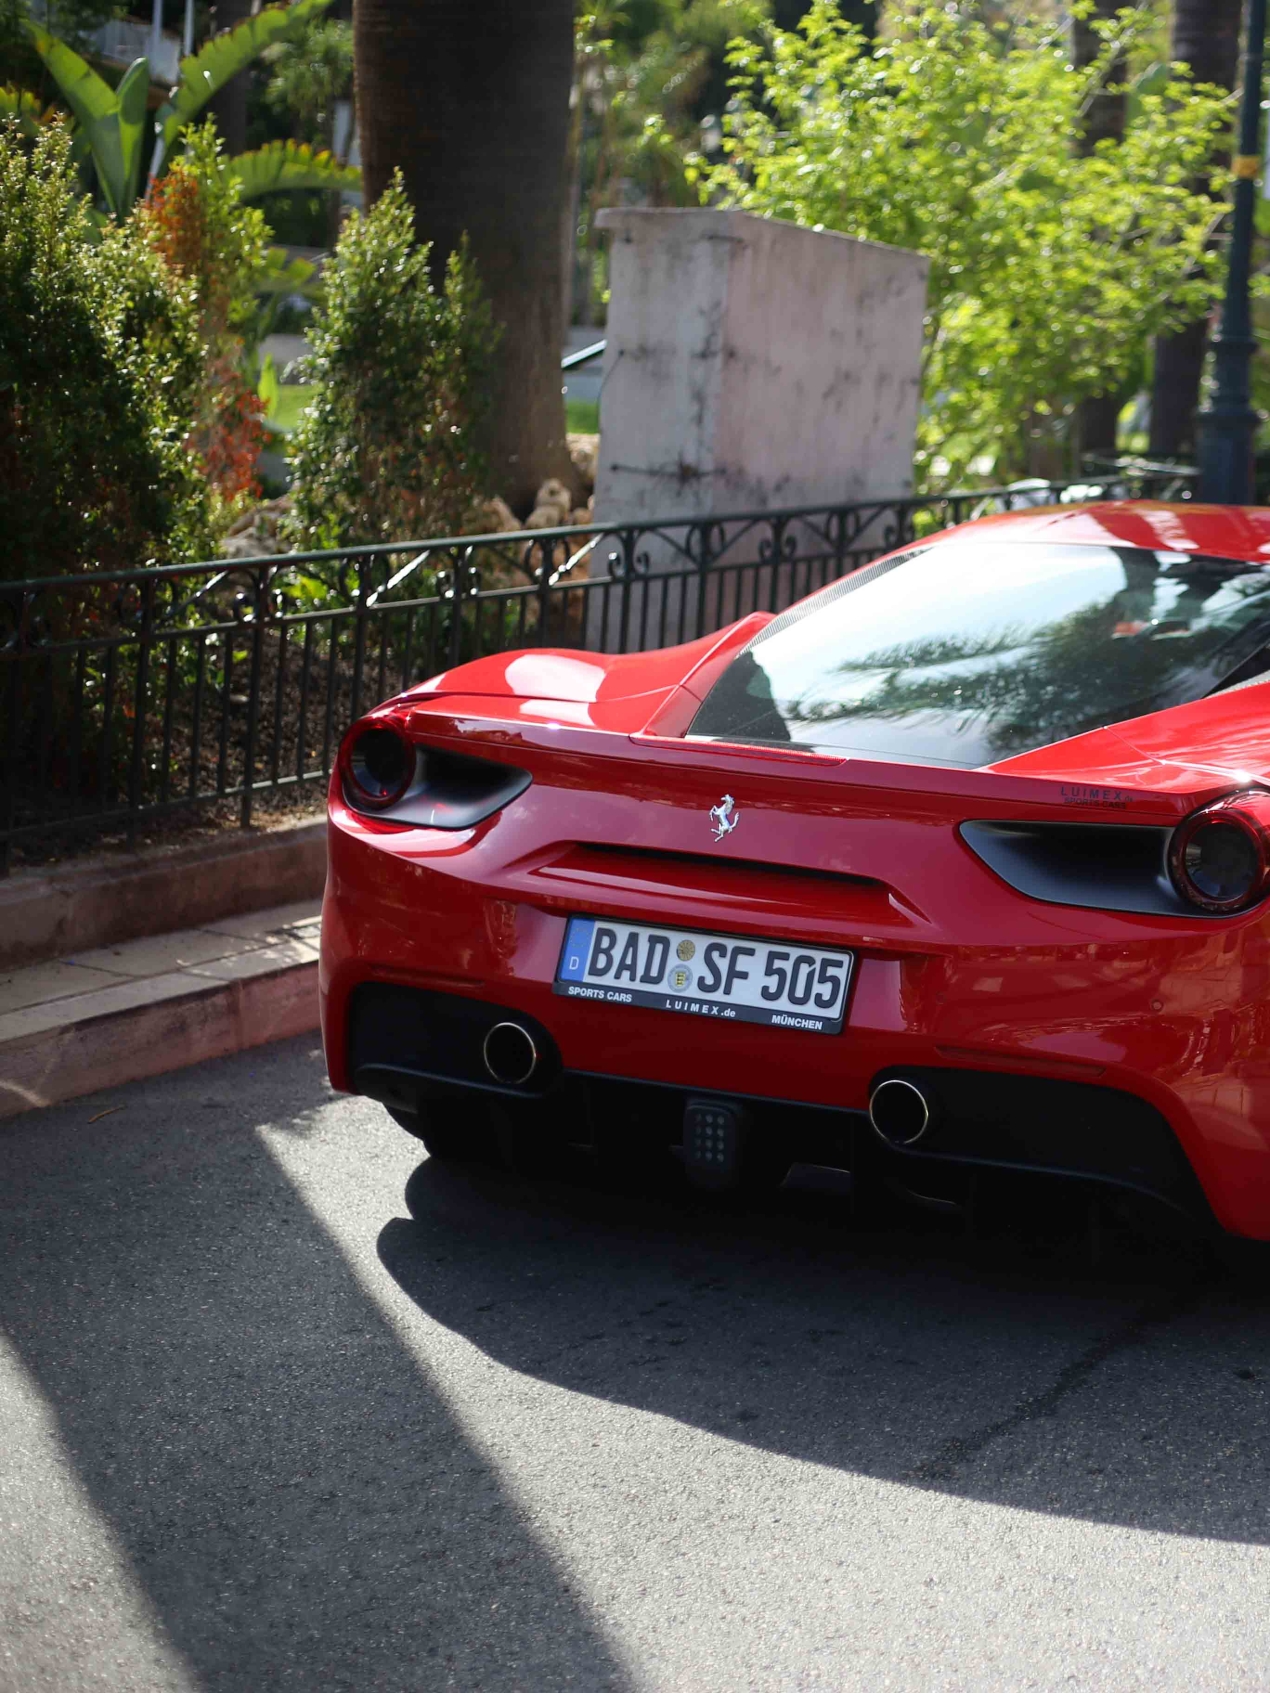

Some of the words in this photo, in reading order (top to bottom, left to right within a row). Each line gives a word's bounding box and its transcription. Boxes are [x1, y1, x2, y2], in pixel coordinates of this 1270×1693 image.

[568, 956, 579, 970] D
[588, 927, 671, 986] BAD
[697, 942, 756, 996] SF
[760, 950, 844, 1009] 505
[568, 986, 604, 999] SPORTS
[606, 991, 632, 1003] CARS
[771, 1014, 823, 1030] MÜNCHEN
